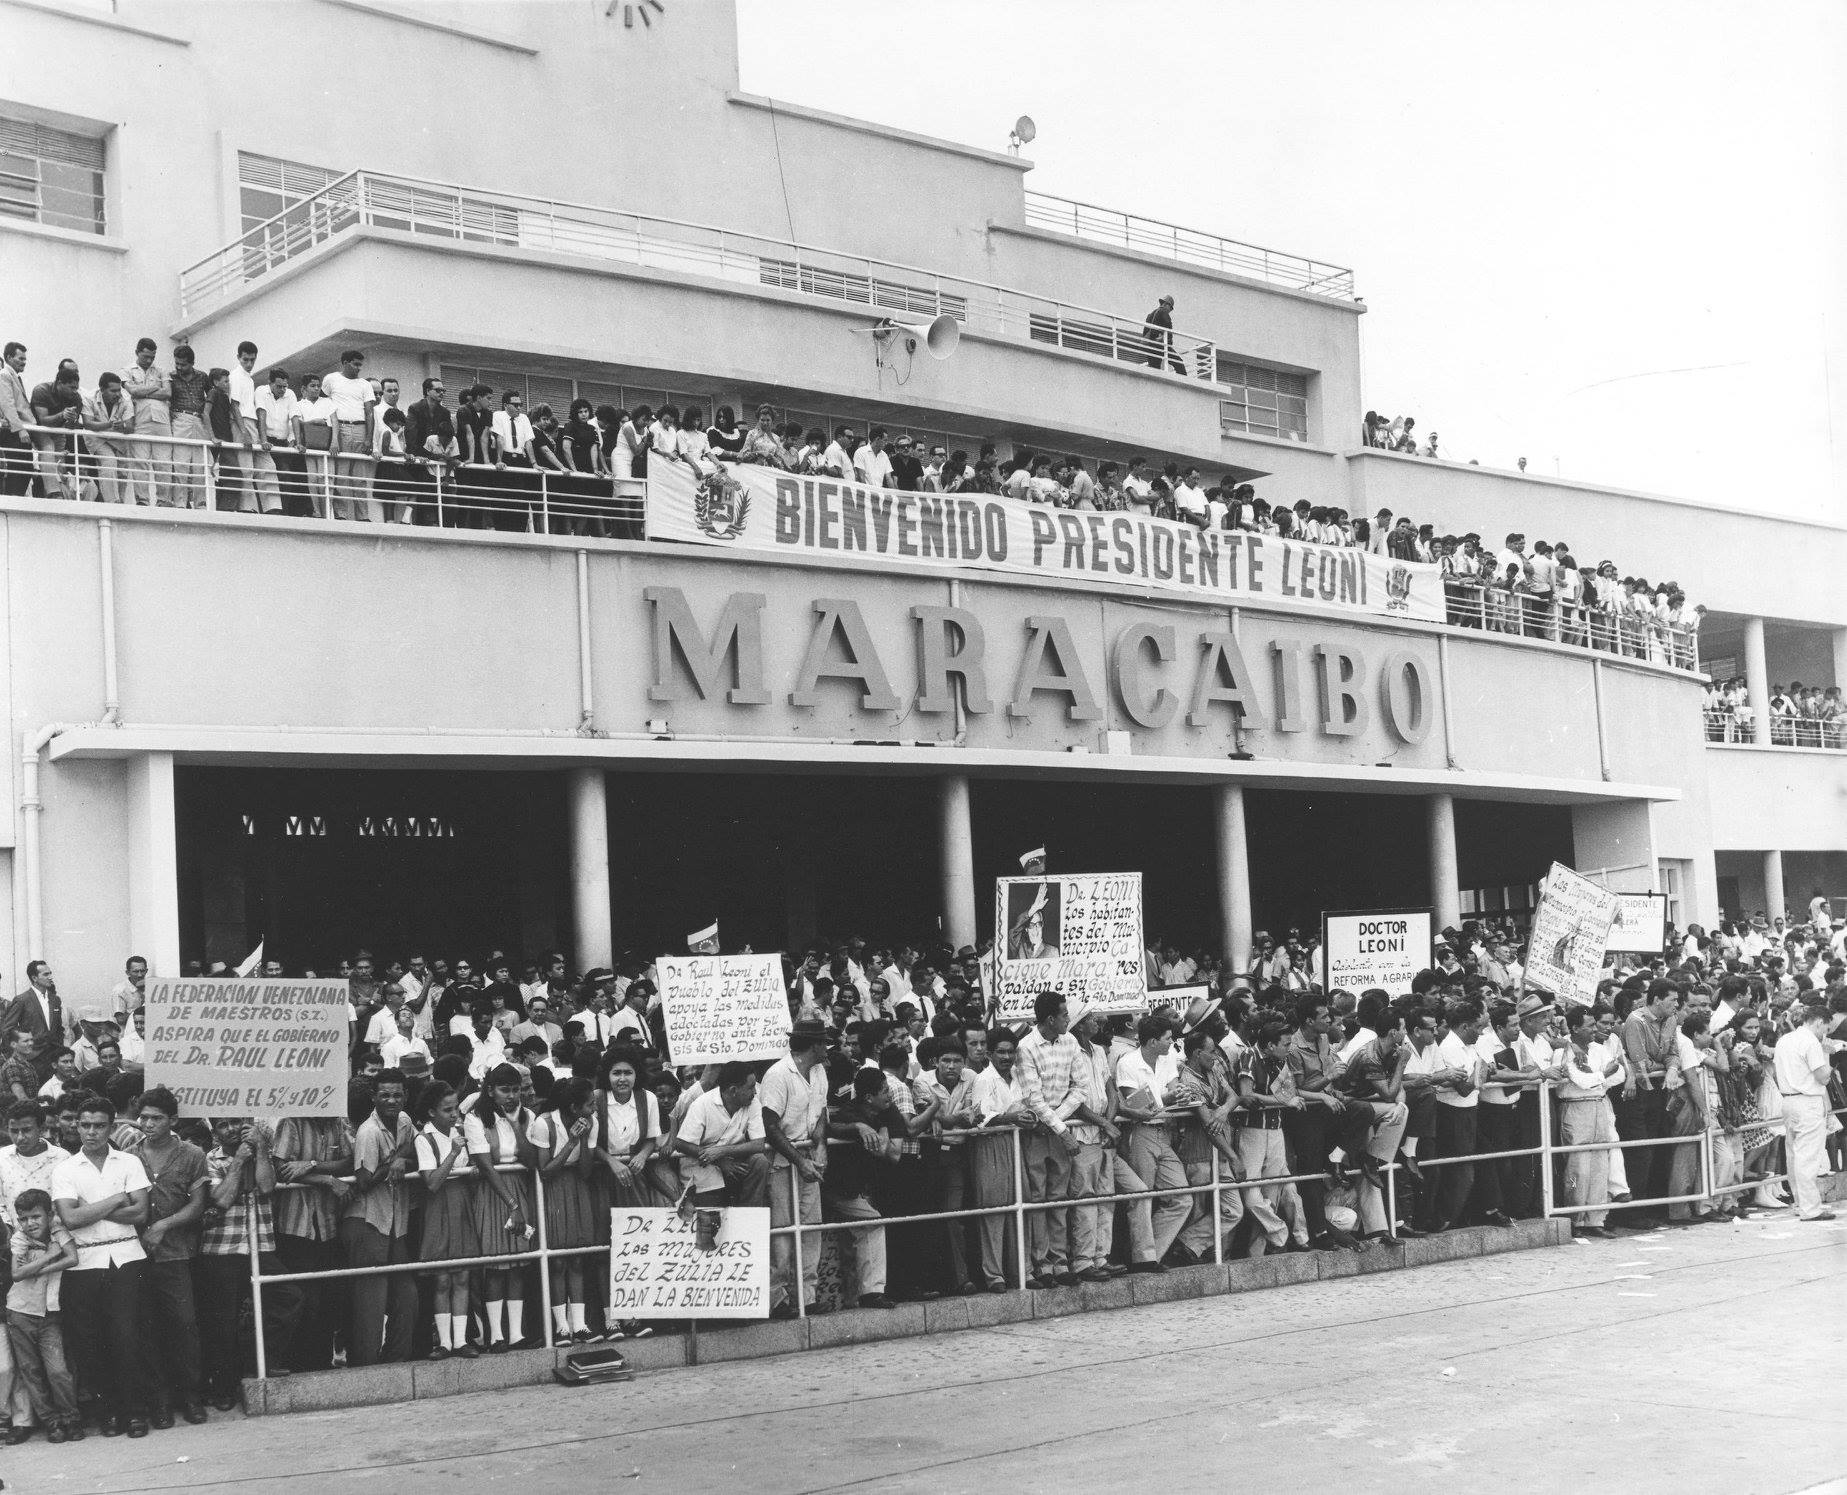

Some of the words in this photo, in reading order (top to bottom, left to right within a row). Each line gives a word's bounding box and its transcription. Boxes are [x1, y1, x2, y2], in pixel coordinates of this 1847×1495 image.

[776, 478, 1007, 562] BIENVENIDO
[1028, 510, 1264, 592] PRESIDENTE
[1282, 542, 1367, 605] LEONI
[643, 586, 1434, 745] MARACAIBO
[1063, 924, 1083, 940] tes
[1086, 922, 1107, 939] del
[1359, 920, 1407, 936] DOCTOR
[1062, 941, 1110, 959] nicipio
[721, 961, 753, 977] Leoni
[759, 963, 771, 977] el
[1003, 962, 1051, 982] cique
[1001, 979, 1051, 999] paldan
[1055, 981, 1064, 991] a
[1068, 979, 1087, 991] su
[1334, 974, 1376, 986] REFORMA
[150, 984, 169, 1004] LA
[172, 984, 261, 1005] FEDERACION
[263, 986, 346, 1005] VENEZOLANA
[668, 981, 713, 1002] pueblo
[721, 980, 740, 998] del
[668, 1002, 707, 1019] apoya
[714, 998, 732, 1011] las
[1003, 999, 1019, 1011] en
[1021, 995, 1035, 1010] la
[167, 1006, 192, 1019] DE
[200, 1006, 293, 1020] MAESTROS
[736, 1016, 760, 1029] por
[152, 1026, 215, 1042] ASPIRA
[220, 1028, 253, 1043] QUE
[255, 1029, 270, 1042] EL
[731, 1027, 757, 1037] ante
[153, 1049, 180, 1063] DEL
[215, 1045, 268, 1068] RAUL
[273, 1047, 331, 1068] LEONI
[673, 1044, 692, 1056] sis
[696, 1041, 708, 1053] de
[736, 1039, 789, 1053] Domingo
[245, 1088, 262, 1107] EL
[266, 1086, 290, 1108] 5%
[298, 1085, 336, 1108] 10%
[726, 1263, 754, 1282] LE
[613, 1286, 650, 1308] DAN
[653, 1286, 677, 1308] LA
[680, 1286, 761, 1308] BIENVENIDA
